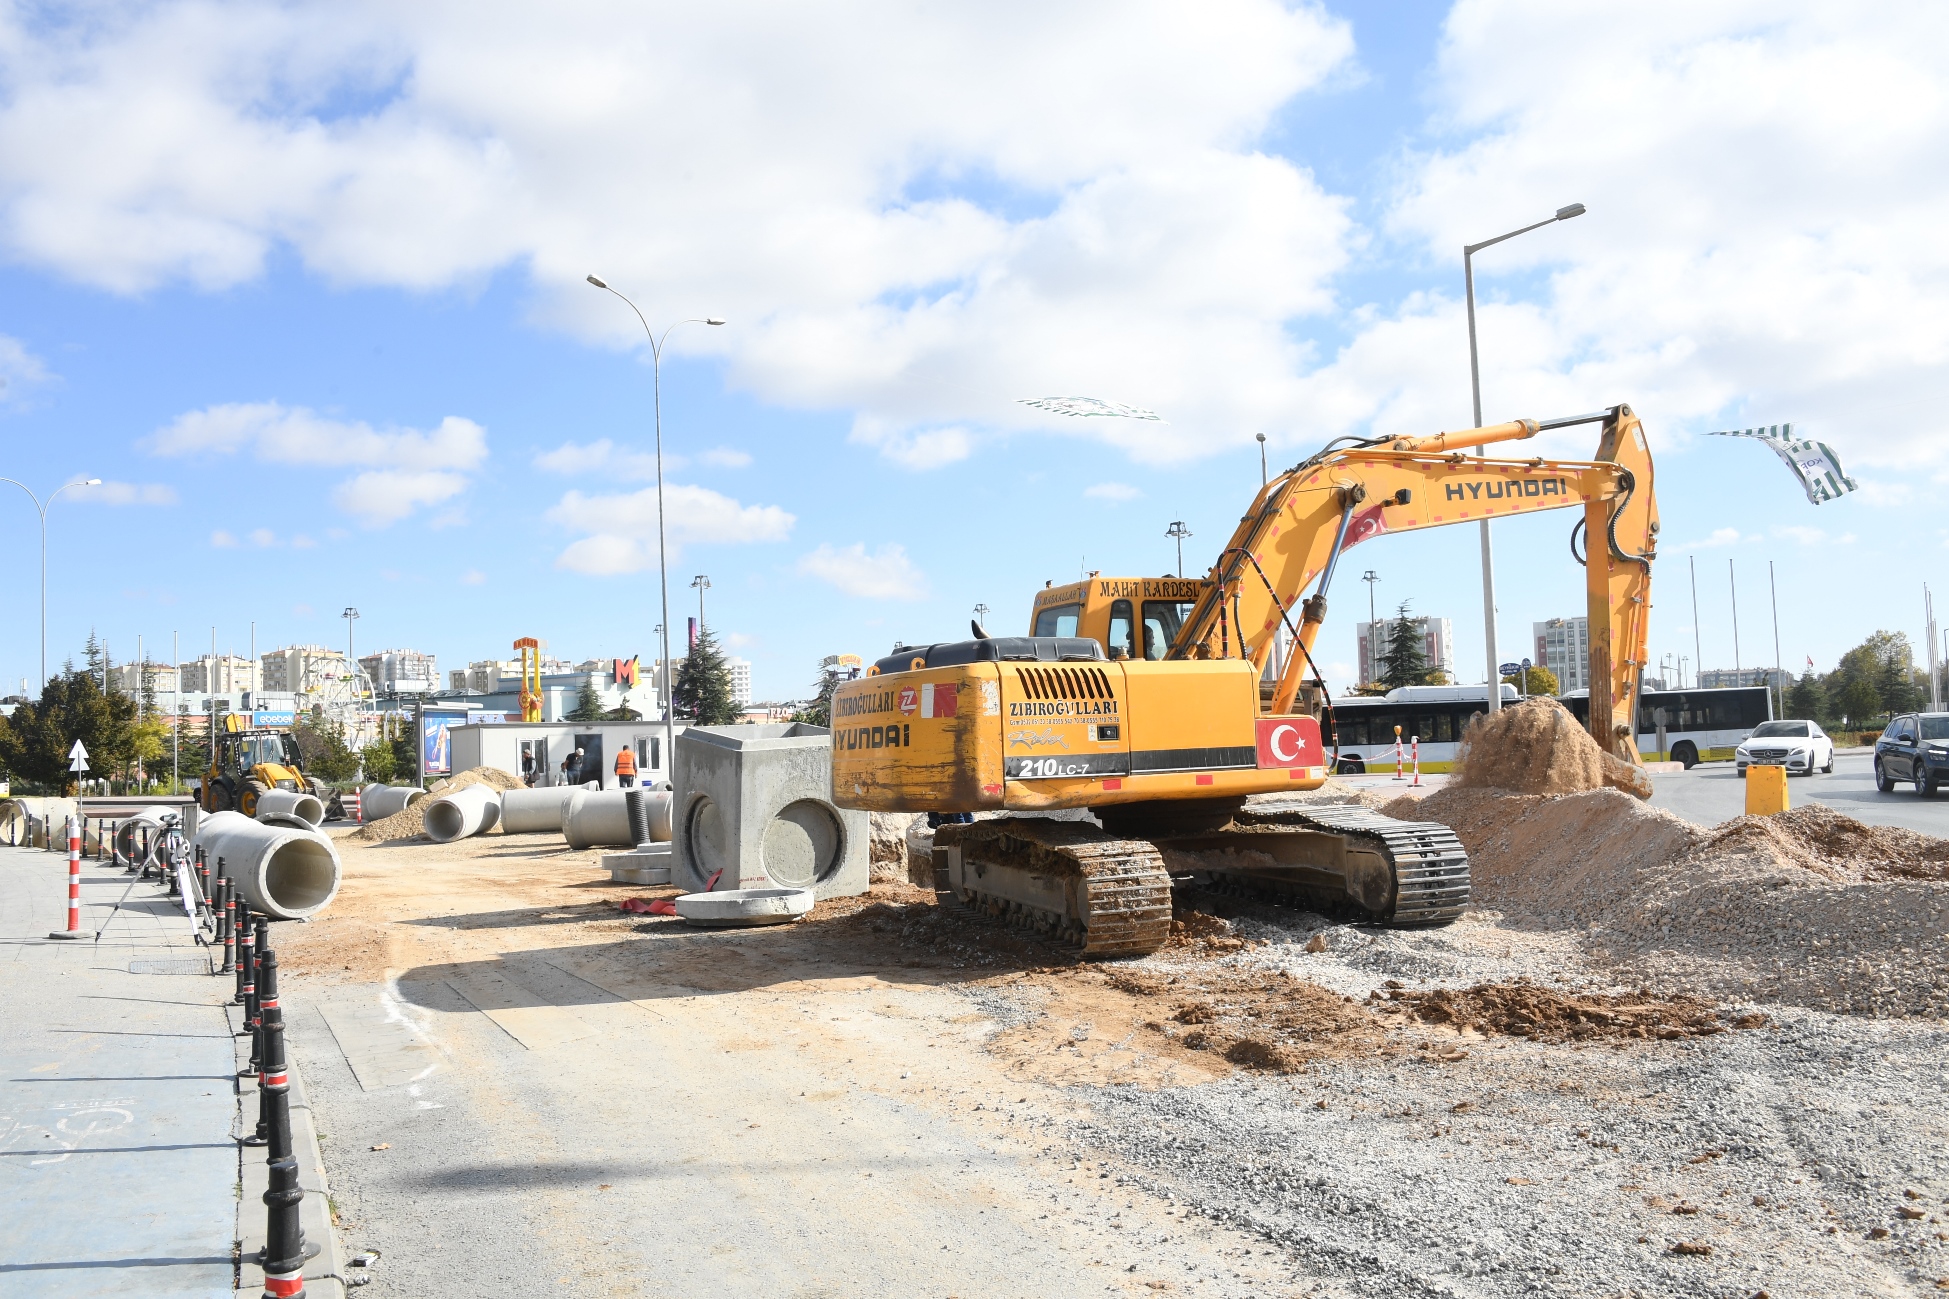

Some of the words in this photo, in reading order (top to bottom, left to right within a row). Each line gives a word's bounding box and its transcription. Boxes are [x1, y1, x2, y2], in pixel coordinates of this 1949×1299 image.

[1445, 478, 1567, 501] HYUNDAI
[1143, 581, 1203, 600] KARDEŞL
[613, 655, 641, 689] M1
[259, 714, 294, 724] ebebek
[770, 707, 789, 718] FLO
[1019, 758, 1058, 777] 210
[1058, 764, 1090, 776] LC-7
